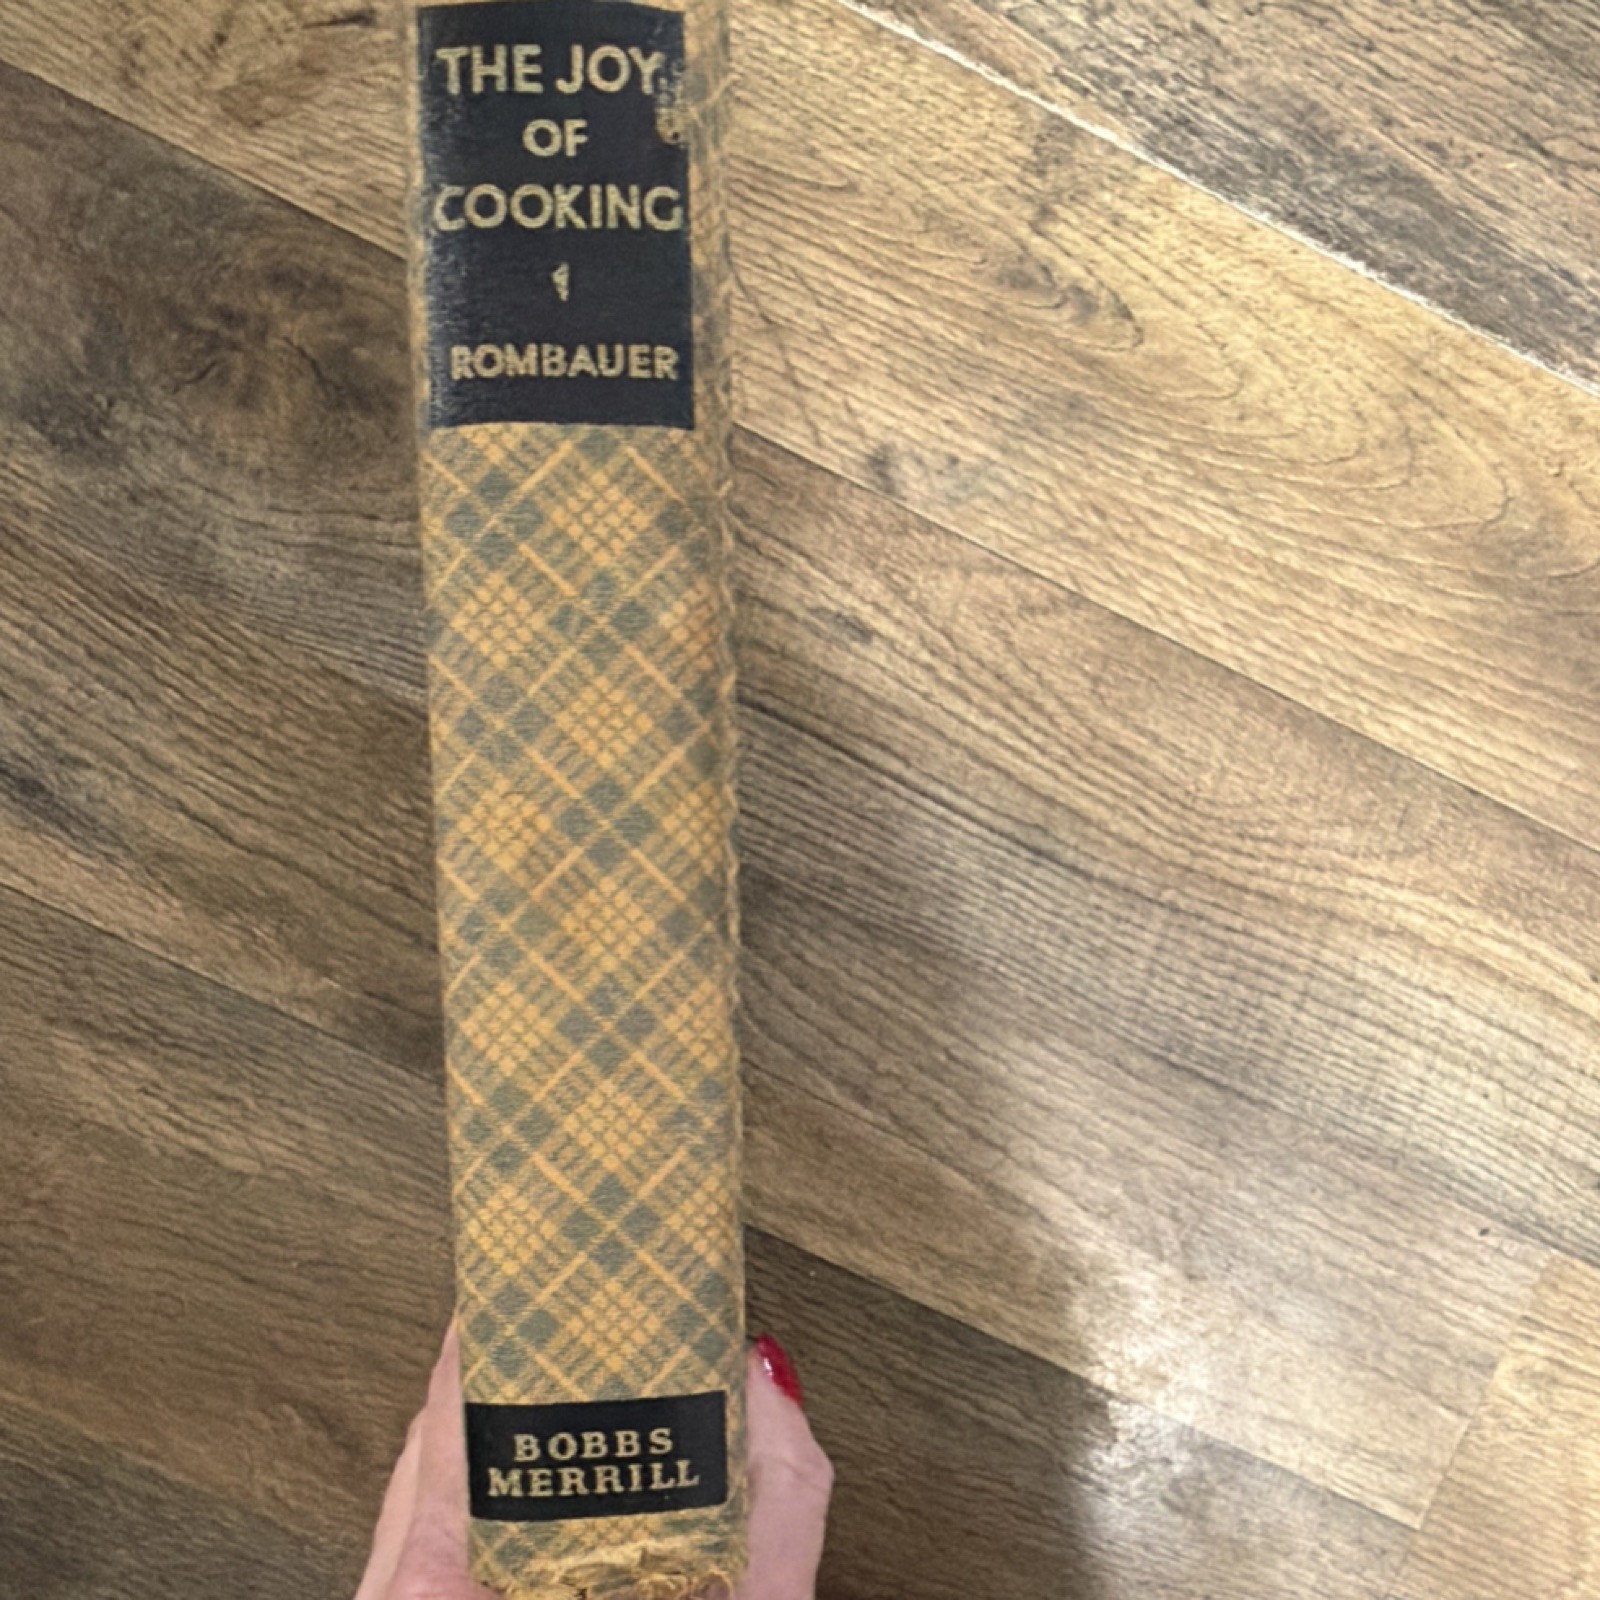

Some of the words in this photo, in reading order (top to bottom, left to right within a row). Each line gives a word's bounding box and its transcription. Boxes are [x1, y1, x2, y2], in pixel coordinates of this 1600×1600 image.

[436, 44, 543, 94] THE
[555, 44, 665, 95] JOY
[522, 118, 589, 157] OF
[433, 183, 684, 231] COOKING
[450, 343, 679, 381] ROMBAUER
[513, 1427, 673, 1463] BOBBS
[487, 1459, 700, 1497] MERRILL
